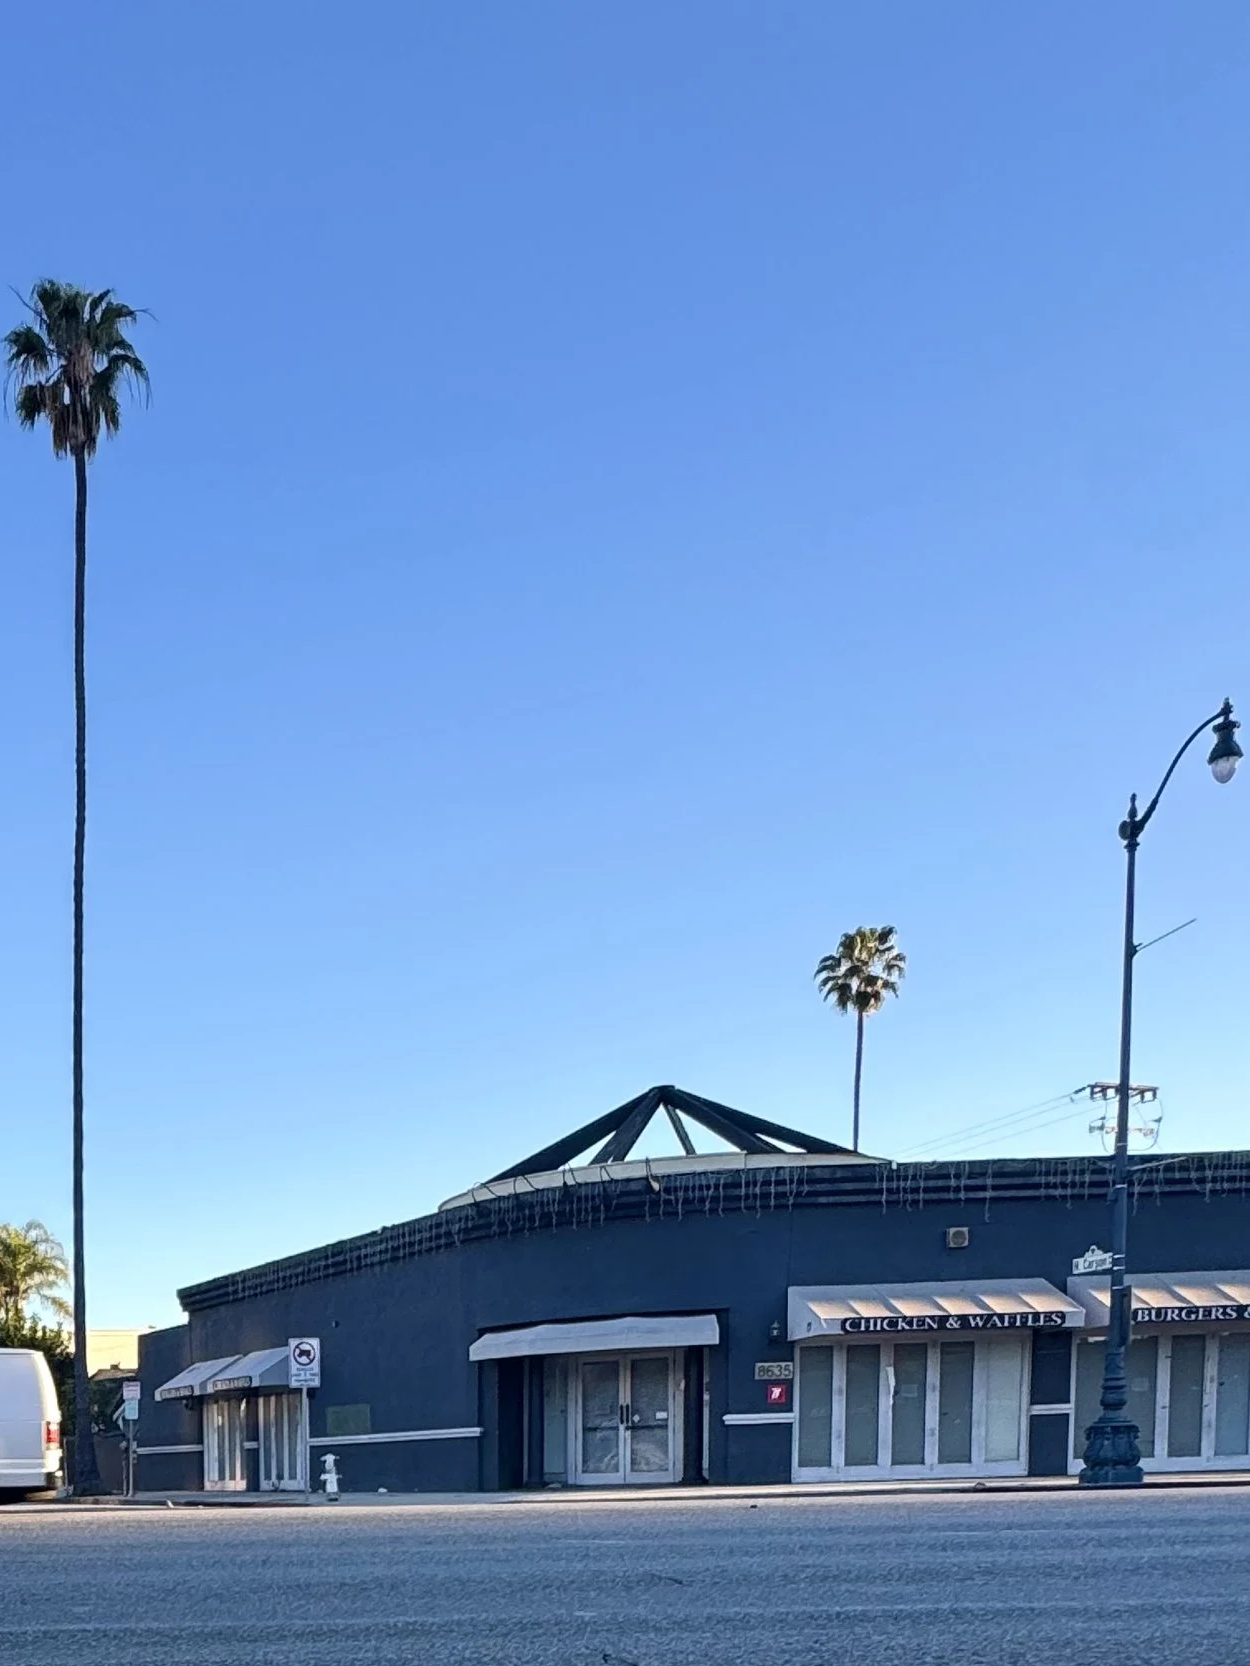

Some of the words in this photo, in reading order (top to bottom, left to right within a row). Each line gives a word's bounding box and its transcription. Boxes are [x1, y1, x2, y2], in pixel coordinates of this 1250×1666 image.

[1136, 1306, 1238, 1322] BURGERS
[844, 1316, 939, 1332] CHICKEN
[945, 1316, 961, 1329] &
[968, 1313, 1063, 1329] WAFFLES
[757, 1364, 792, 1377] 8635
